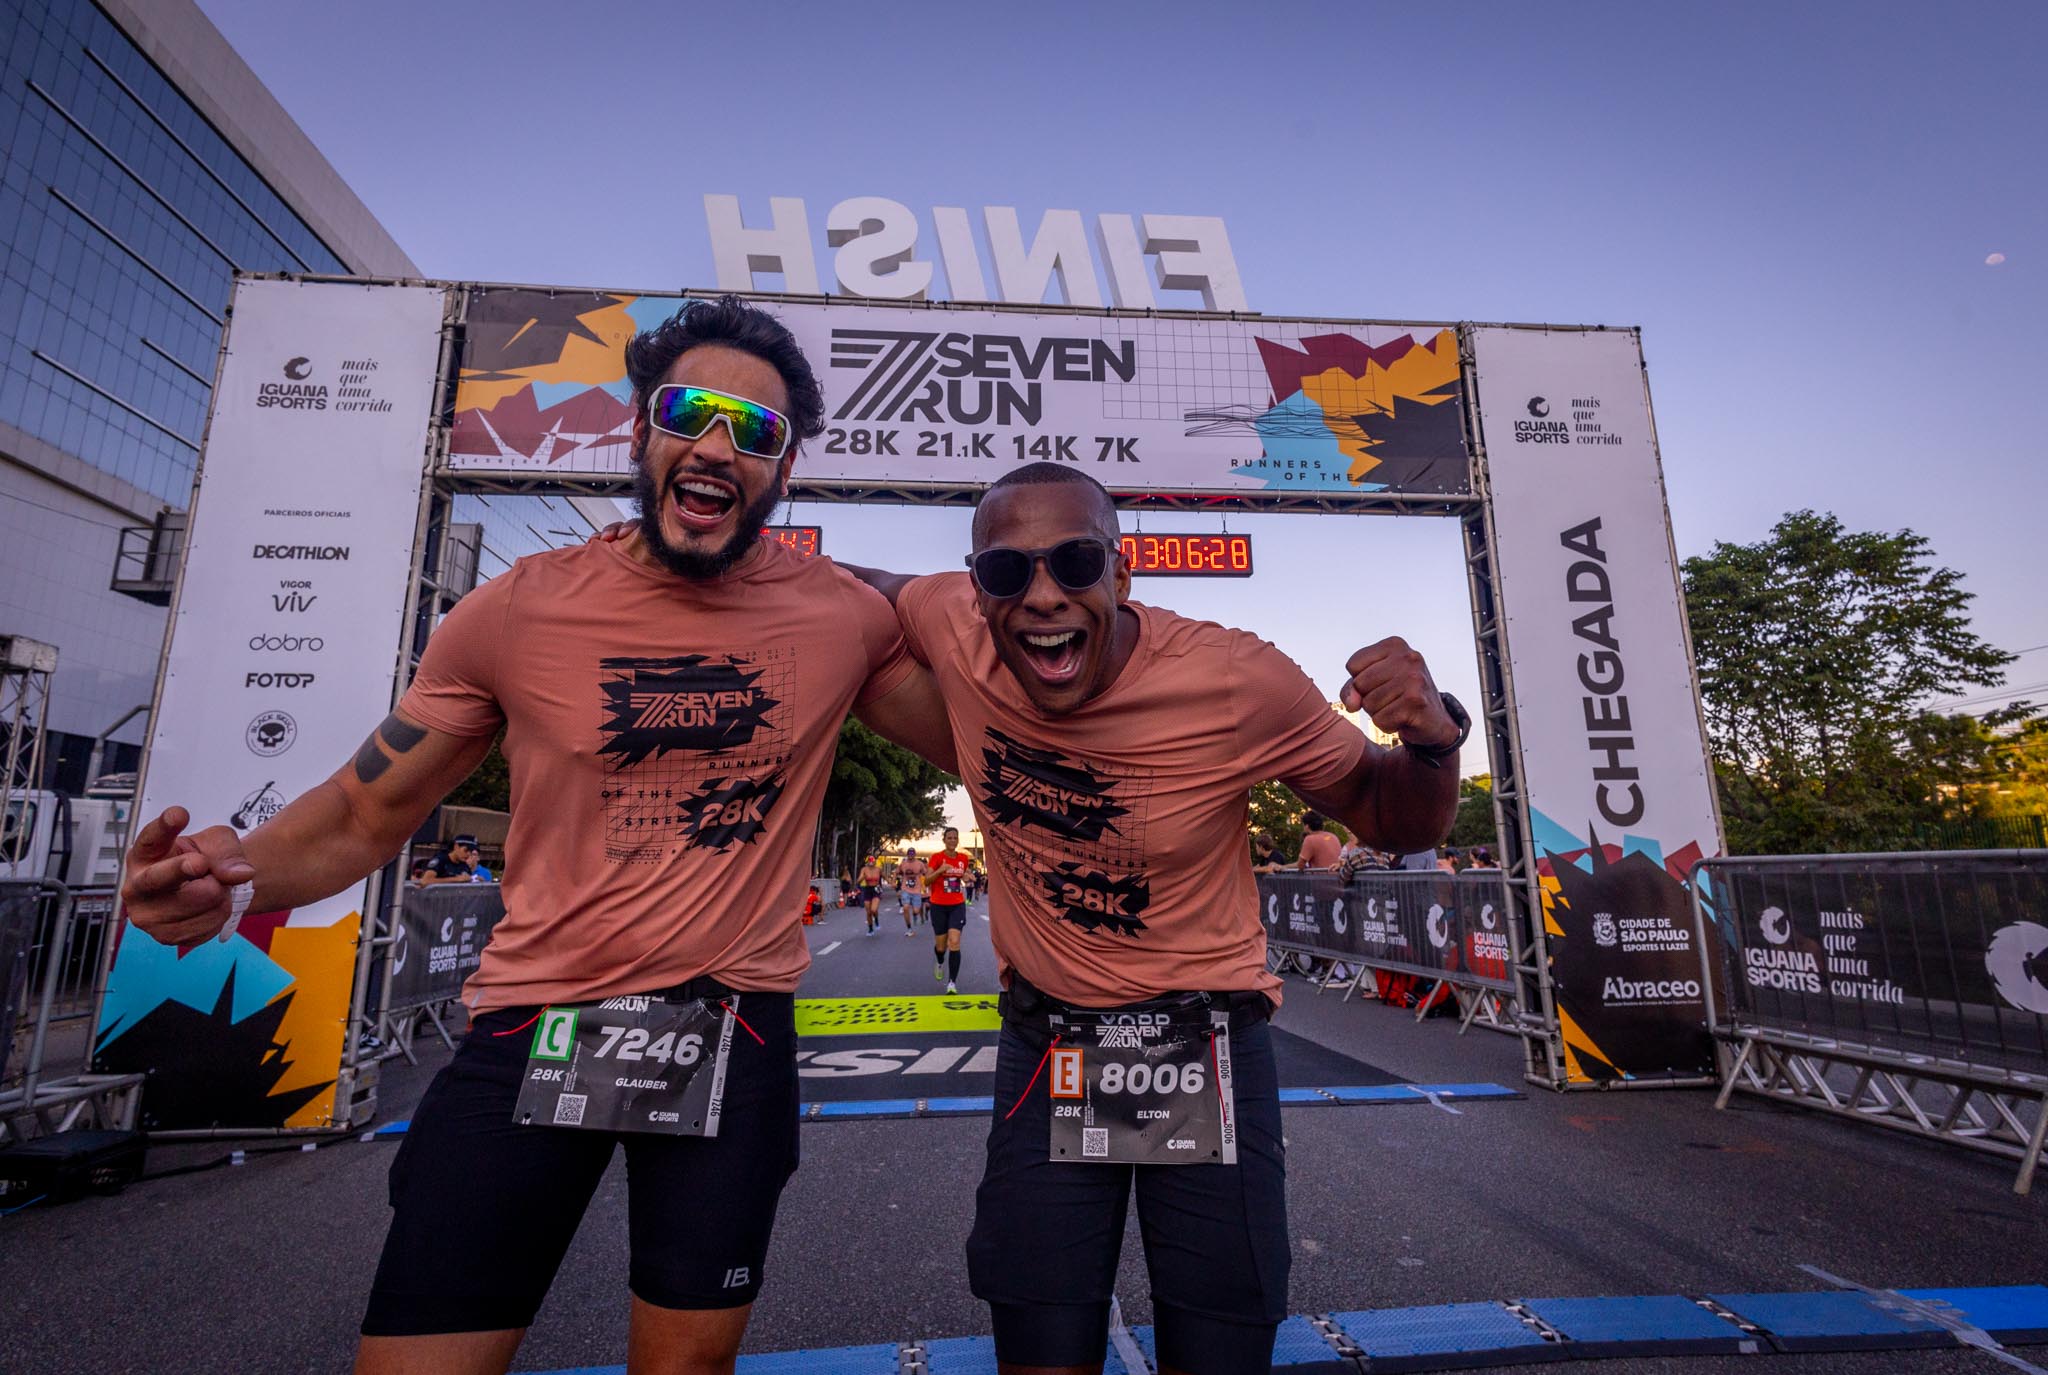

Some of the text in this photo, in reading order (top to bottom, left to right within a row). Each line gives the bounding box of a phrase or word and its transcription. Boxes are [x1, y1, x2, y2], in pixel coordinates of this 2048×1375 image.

[341, 358, 378, 371] mais
[935, 332, 1136, 382] SEVEN
[339, 373, 368, 387] que
[259, 383, 328, 397] IGUANA
[337, 387, 371, 398] uma
[256, 396, 327, 410] SPORTS
[335, 399, 393, 413] corrida
[900, 379, 1042, 426] RUN
[1571, 396, 1601, 408] mais
[1573, 410, 1595, 422] que
[1514, 420, 1568, 433] IGUANA
[1575, 423, 1602, 433] uma
[826, 428, 900, 455] 28K
[1012, 434, 1079, 461] 14K
[1095, 436, 1141, 463] 7K
[1515, 432, 1570, 444] SPORTS
[1577, 433, 1622, 445] corrida
[1231, 458, 1322, 469] RUNNERS
[1284, 472, 1354, 481] OF THE
[264, 509, 351, 518] PARCEIROS OFICIAIS
[253, 545, 350, 560] DECATHLON
[1121, 537, 1248, 569] 03:06:28
[280, 580, 312, 589] VIGOR
[249, 633, 324, 651] dobro
[1560, 516, 1645, 827] CHEGADA
[245, 673, 315, 688] FOTOP
[672, 690, 753, 709] SEVEN
[250, 713, 294, 734] BLACK SKULL
[661, 709, 717, 728] RUN
[708, 754, 793, 770] RUNNERS
[638, 790, 673, 798] THE
[1029, 779, 1103, 809] SEVEN
[258, 804, 283, 815] KISS
[699, 795, 763, 828] 28K
[1024, 793, 1069, 815] RUN
[1061, 883, 1129, 916] 28K
[1619, 918, 1671, 929] CIDADE DE
[1820, 907, 1864, 929] mais
[1363, 931, 1386, 944] SPORTS
[1473, 931, 1508, 947] IGUANA
[1620, 929, 1690, 942] SÃO PAULO
[1622, 942, 1690, 952] ESPORTES E LAZER
[1823, 933, 1857, 955] que
[1474, 944, 1509, 961] SPORTS
[1745, 947, 1820, 973] IGUANA
[428, 957, 457, 974] SPORTS
[1827, 955, 1869, 976] uma
[1602, 976, 1700, 1000] Abraceo
[1747, 966, 1822, 994] SPORTS
[1830, 978, 1904, 1004] corrida
[614, 996, 649, 1013] RUN
[546, 1015, 567, 1053] C
[1118, 1025, 1162, 1037] SEVEN
[593, 1025, 704, 1066] 7246
[720, 1034, 732, 1053] 7246
[1112, 1036, 1143, 1048] RUN
[530, 1068, 565, 1082] 28K
[1061, 1056, 1073, 1091] E
[1219, 1059, 1230, 1080] 8006
[615, 1077, 668, 1091] GLAUBER
[1099, 1062, 1206, 1095] 8006
[710, 1098, 722, 1117] 7246
[1054, 1105, 1082, 1118] 28K
[1136, 1110, 1171, 1120] ELTON
[1224, 1123, 1234, 1145] 8006
